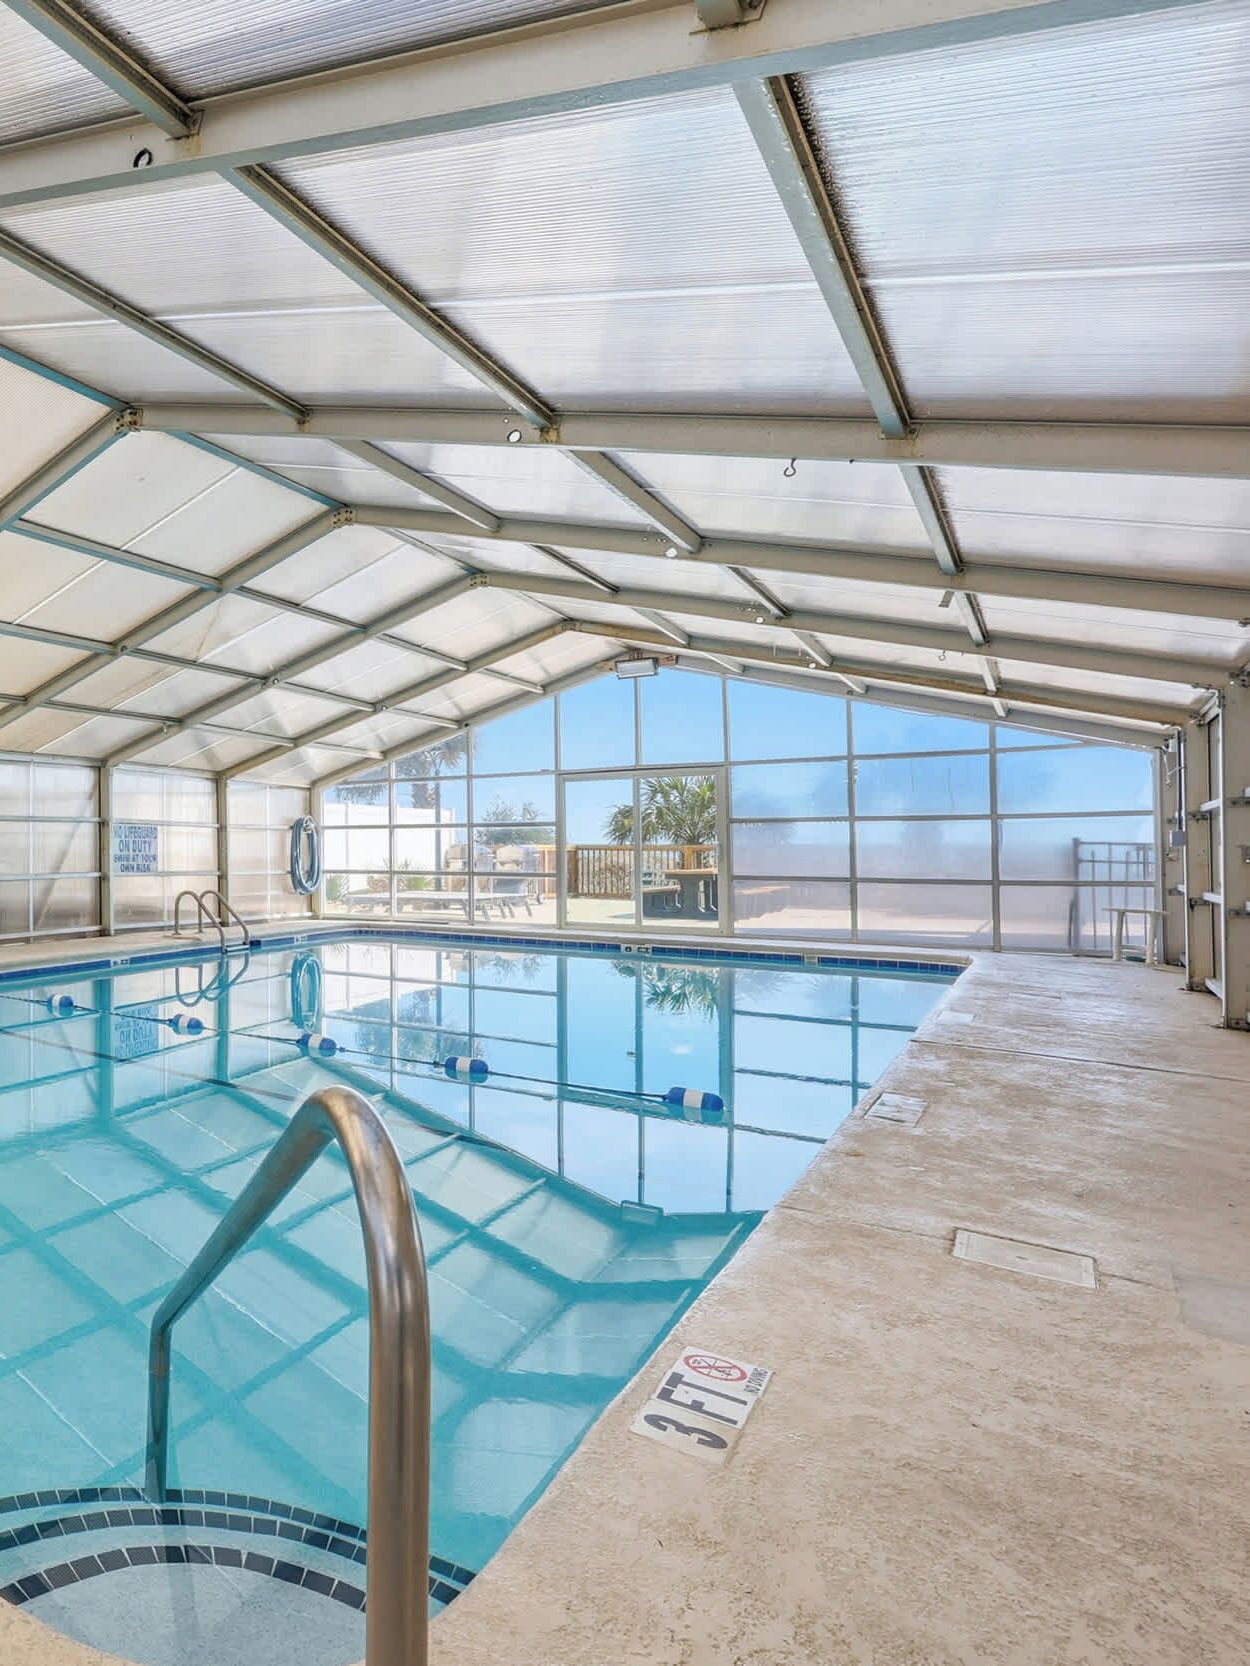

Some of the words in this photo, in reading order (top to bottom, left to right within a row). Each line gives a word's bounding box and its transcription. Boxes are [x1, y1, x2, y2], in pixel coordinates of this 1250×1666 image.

[118, 839, 130, 852] ON
[132, 839, 151, 852] DUTY
[656, 1371, 748, 1426] FT
[643, 1414, 728, 1449] 3
